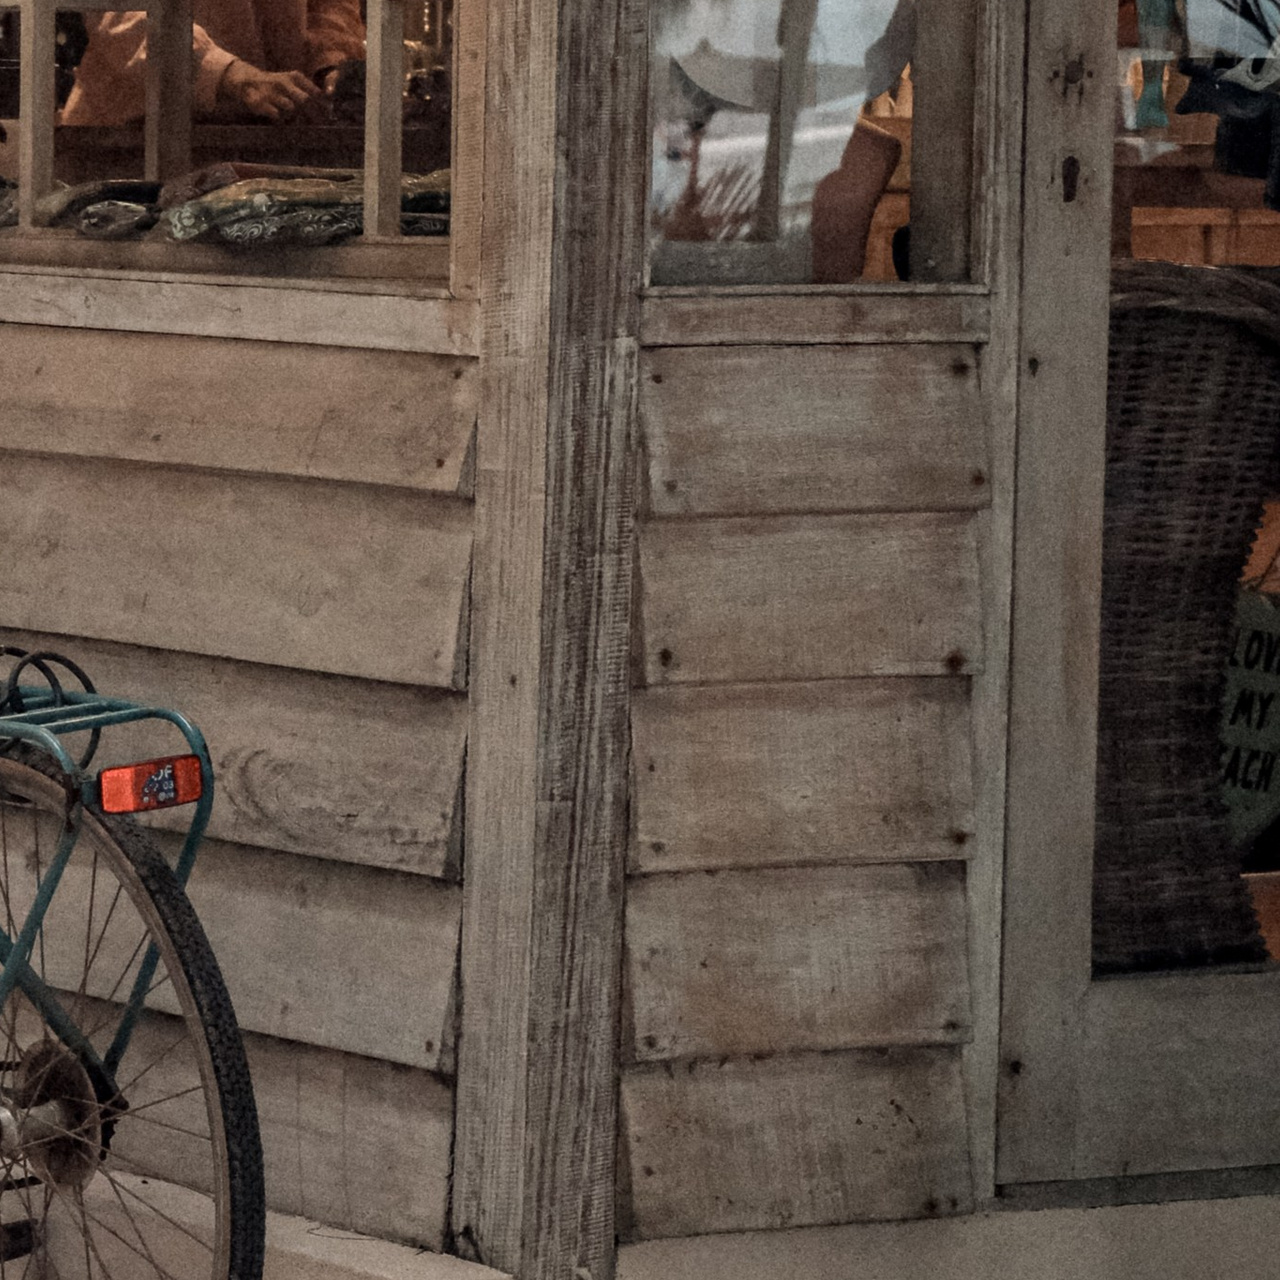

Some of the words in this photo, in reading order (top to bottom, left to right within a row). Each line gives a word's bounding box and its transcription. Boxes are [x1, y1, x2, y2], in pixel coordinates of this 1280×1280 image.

[1229, 627, 1280, 675] LOV
[1229, 688, 1276, 731] MY
[1220, 745, 1278, 793] ACH
